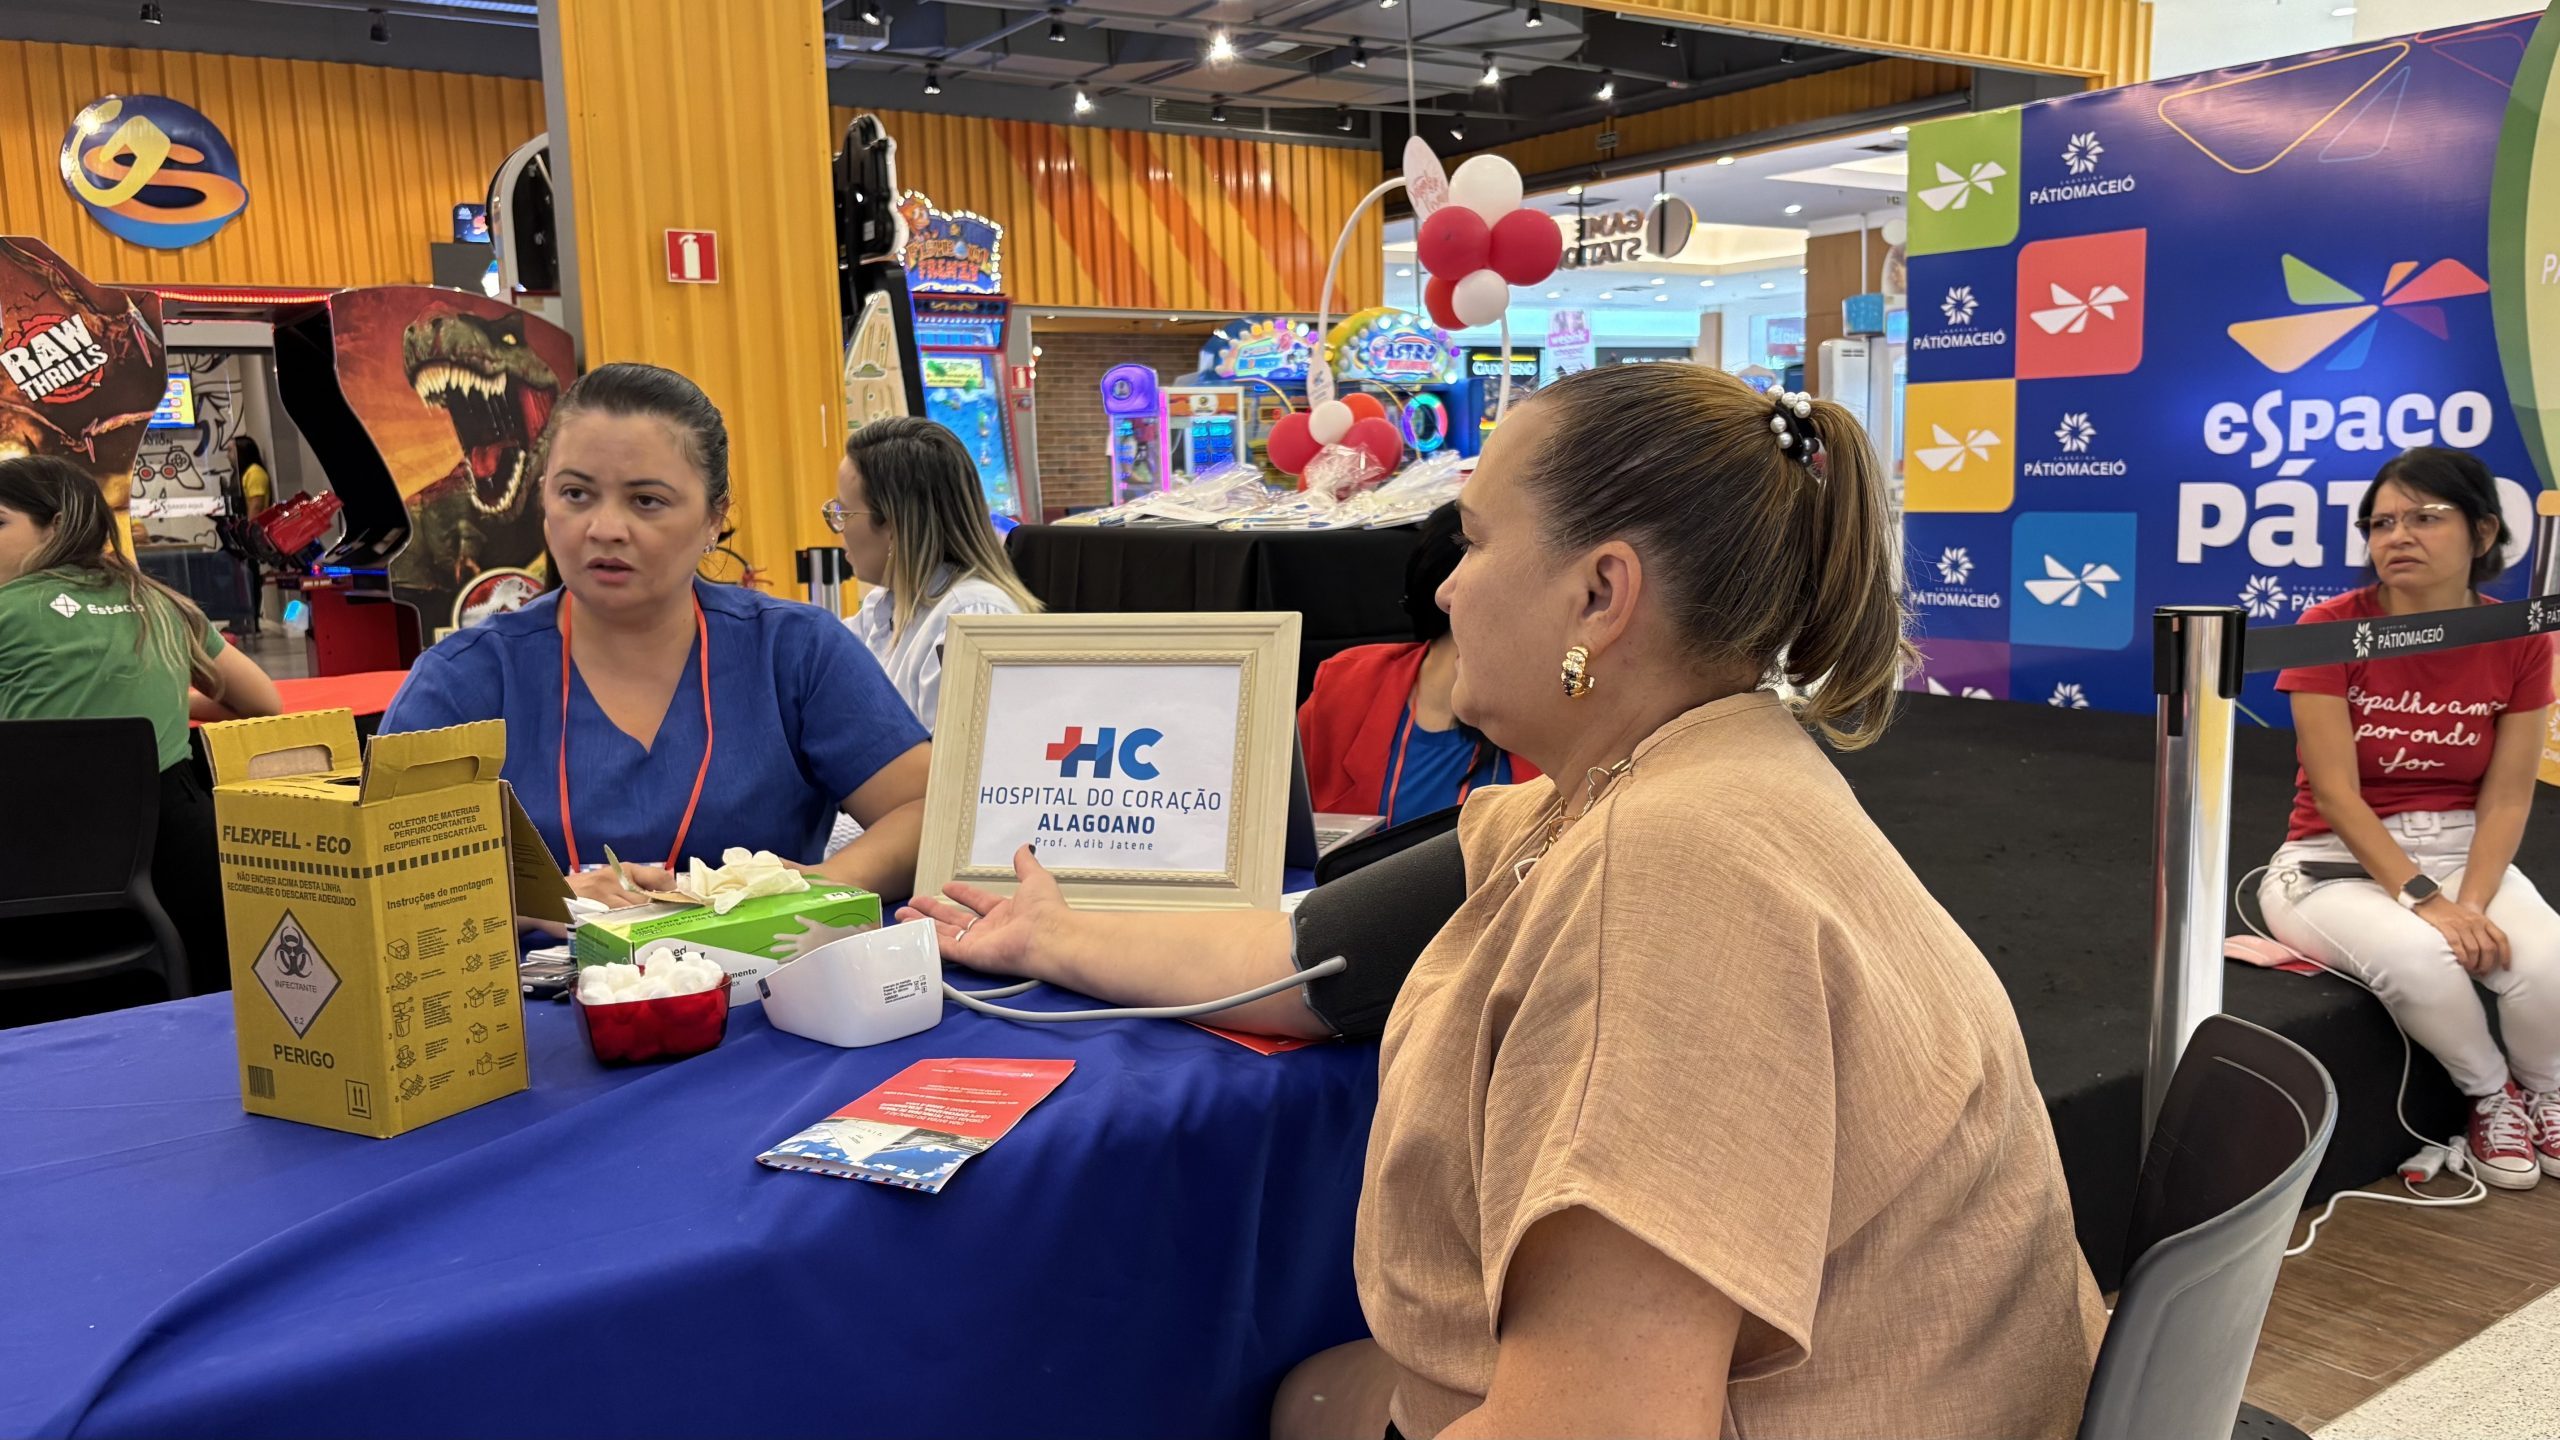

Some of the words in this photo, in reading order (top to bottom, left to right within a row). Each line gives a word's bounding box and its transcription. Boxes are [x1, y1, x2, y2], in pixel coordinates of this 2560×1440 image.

[2029, 174, 2135, 205] PÁTIOMACEIÓ
[918, 260, 980, 282] FRENZY
[0, 314, 93, 385] RAW
[1913, 328, 2006, 350] PÁTIOMACEIÓ
[19, 344, 109, 402] THRILLS
[2024, 459, 2126, 477] PÁTIOMACEIÓ
[2377, 624, 2445, 650] PÁTIOMACEIÓ
[2354, 723, 2410, 742] por
[2410, 721, 2481, 746] onde
[980, 786, 1077, 806] HOSPITAL
[1087, 788, 1114, 807] DO
[1122, 788, 1221, 815] CORAÇÃO
[388, 816, 428, 831] COLETOR
[429, 813, 440, 823] DE
[440, 805, 480, 820] MATERIAIS
[394, 814, 477, 839] PERFUROCORTANTES
[1037, 813, 1156, 835] ALAGOANO
[223, 825, 302, 850] FLEXPELL
[316, 834, 352, 855] ECO
[383, 834, 432, 853] RECIPIENTE
[433, 823, 488, 842] DESCARTÁVEL
[1035, 836, 1067, 848] Prof.
[1074, 838, 1104, 849] Adib
[1110, 838, 1153, 851] Jatene
[227, 881, 275, 897] RECOMENDA-SE
[275, 889, 280, 897] O
[281, 890, 317, 902] DESCARTE
[318, 893, 357, 907] ADEQUADO
[236, 871, 251, 882] NÃO
[251, 874, 277, 886] ENCHER
[277, 877, 299, 888] ACIMA
[299, 880, 321, 891] DESTA
[387, 891, 436, 910] Instruções
[437, 887, 448, 897] de
[449, 877, 494, 895] montagem
[423, 894, 468, 911] Instrucciones
[275, 979, 317, 994] INFECTANTE
[273, 1043, 335, 1069] PERIGO
